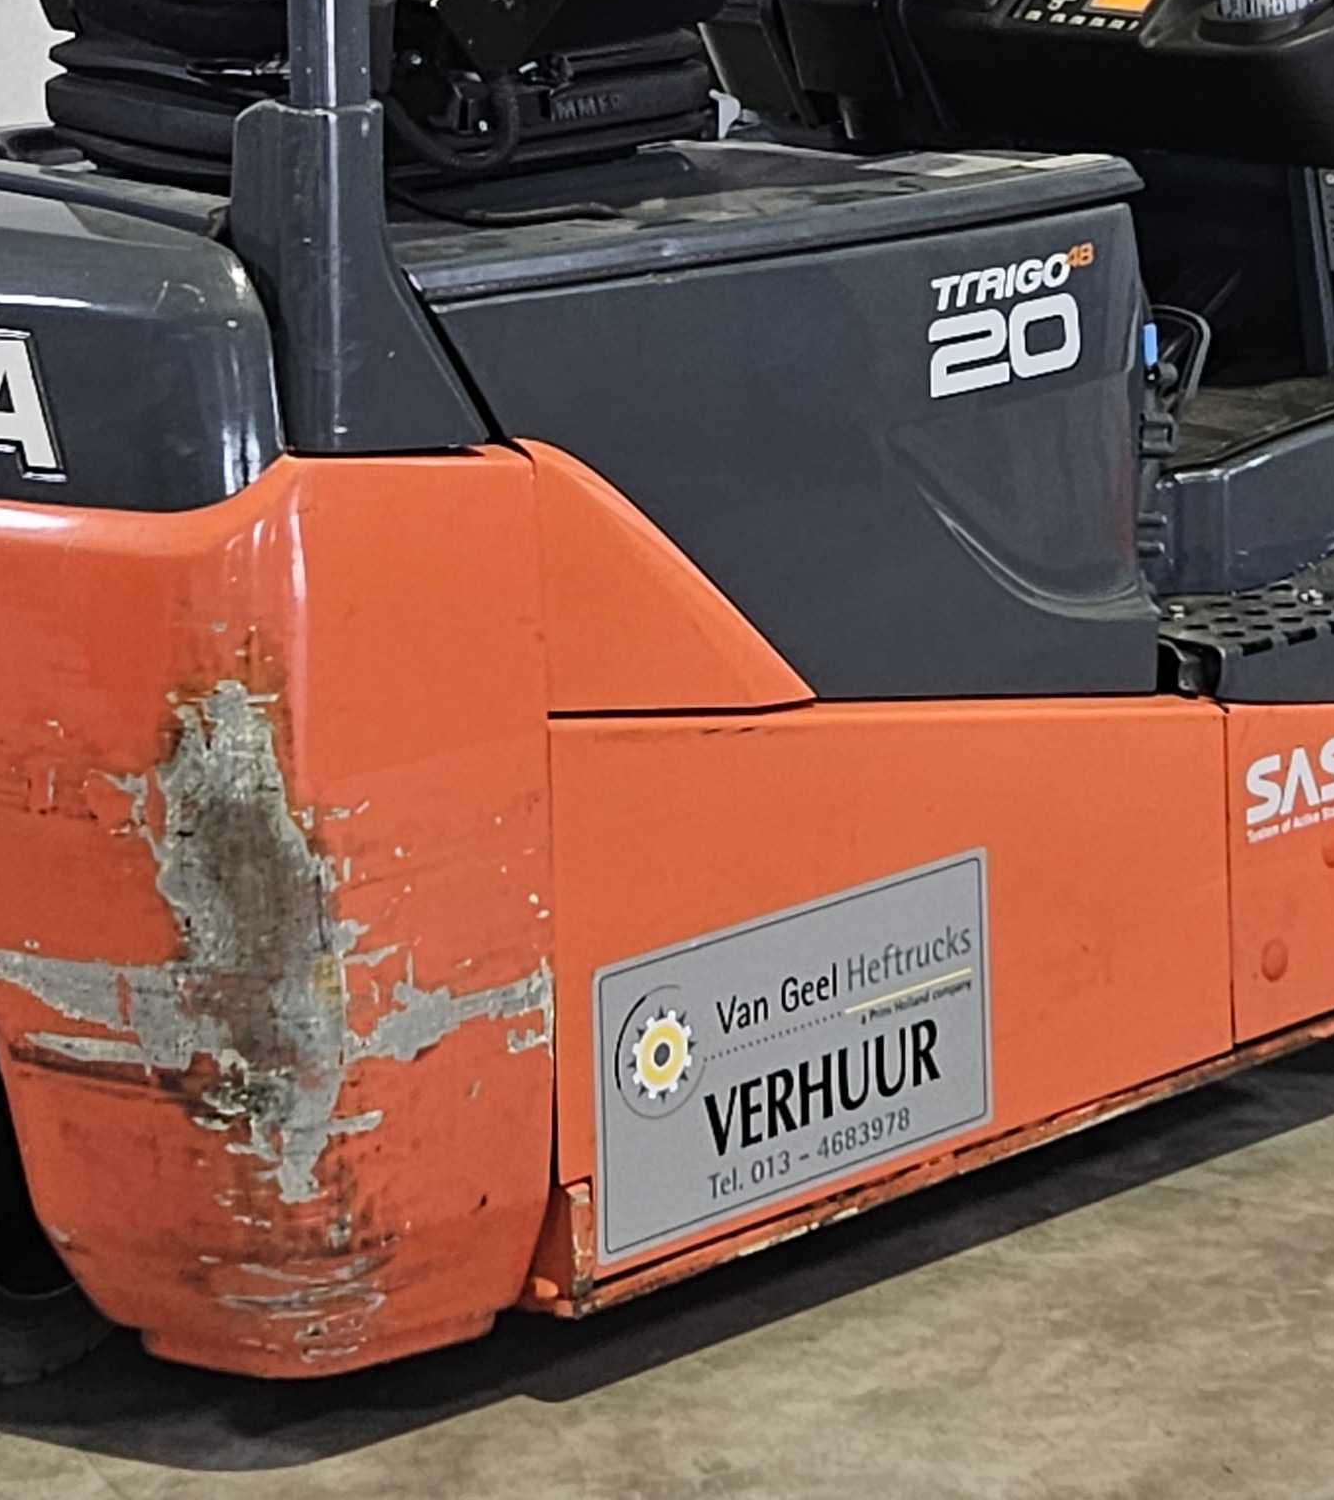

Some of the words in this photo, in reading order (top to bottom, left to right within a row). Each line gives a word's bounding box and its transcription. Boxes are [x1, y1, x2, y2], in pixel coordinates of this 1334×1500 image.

[928, 292, 1081, 399] 20
[716, 995, 769, 1035] Van
[780, 961, 838, 1014] Geel
[847, 926, 973, 992] Heftrucks
[703, 1018, 941, 1157] VERHUUR
[707, 1166, 744, 1200] Tel.
[751, 1149, 791, 1185] 013
[816, 1106, 911, 1160] 4683978
